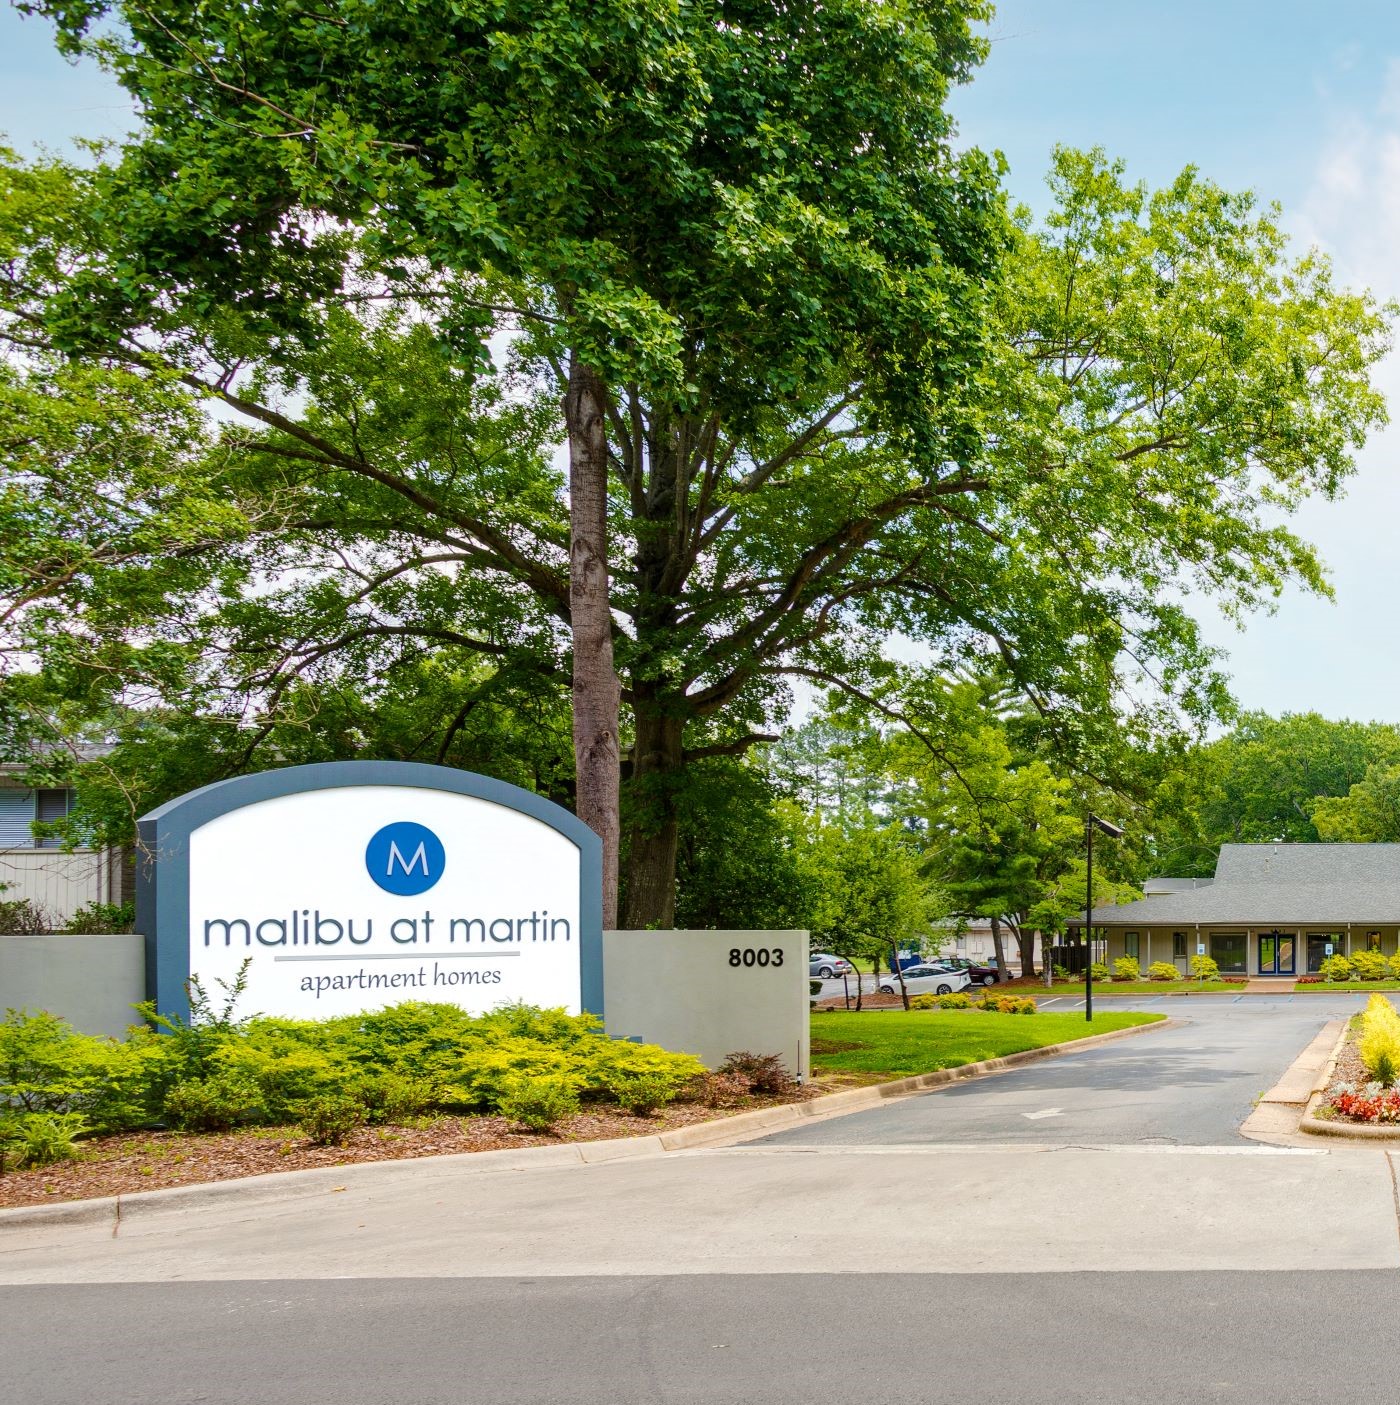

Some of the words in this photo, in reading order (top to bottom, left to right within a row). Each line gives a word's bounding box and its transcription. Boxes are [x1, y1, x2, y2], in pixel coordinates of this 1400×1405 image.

[385, 840, 430, 876] M
[204, 909, 373, 946] malibu
[390, 910, 435, 944] at
[450, 910, 571, 943] martin
[728, 948, 784, 968] 8003
[300, 967, 426, 999] apartment
[434, 962, 502, 986] homes
